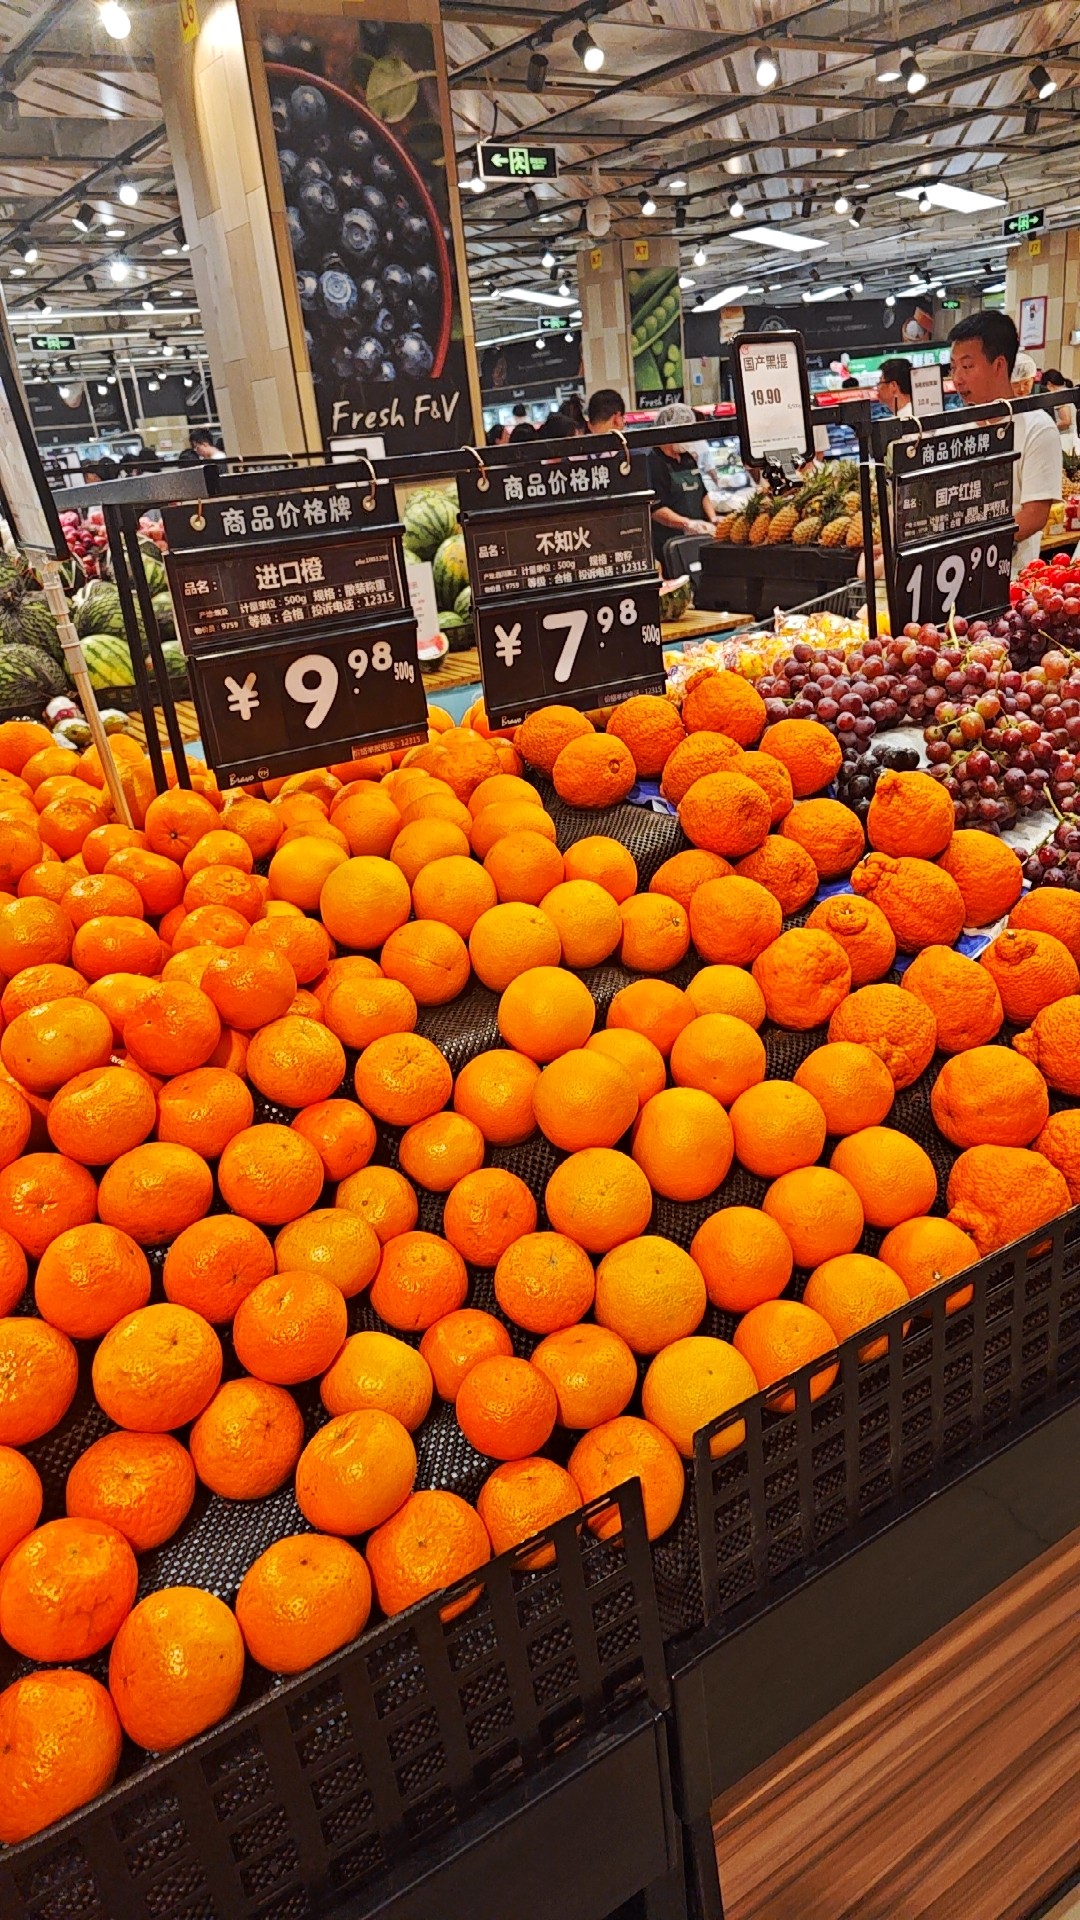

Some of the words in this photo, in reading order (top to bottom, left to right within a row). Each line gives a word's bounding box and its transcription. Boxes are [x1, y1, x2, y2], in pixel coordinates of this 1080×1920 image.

[743, 354, 788, 371] 国产黑提
[639, 395, 664, 408] Fresh
[751, 388, 781, 406] 19.90
[333, 398, 404, 432] Fresh
[415, 391, 459, 425] F&V
[922, 433, 990, 465] 商品价格牌
[503, 465, 610, 501] 商品价格牌
[936, 480, 981, 508] 国产红提
[220, 495, 352, 536] 商品价格牌
[535, 526, 591, 556] 不知火
[255, 556, 326, 591] 进口橙
[641, 624, 661, 646] 500g
[393, 661, 415, 684] 500g
[501, 715, 523, 727] Bravo
[229, 772, 255, 787] Bravo
